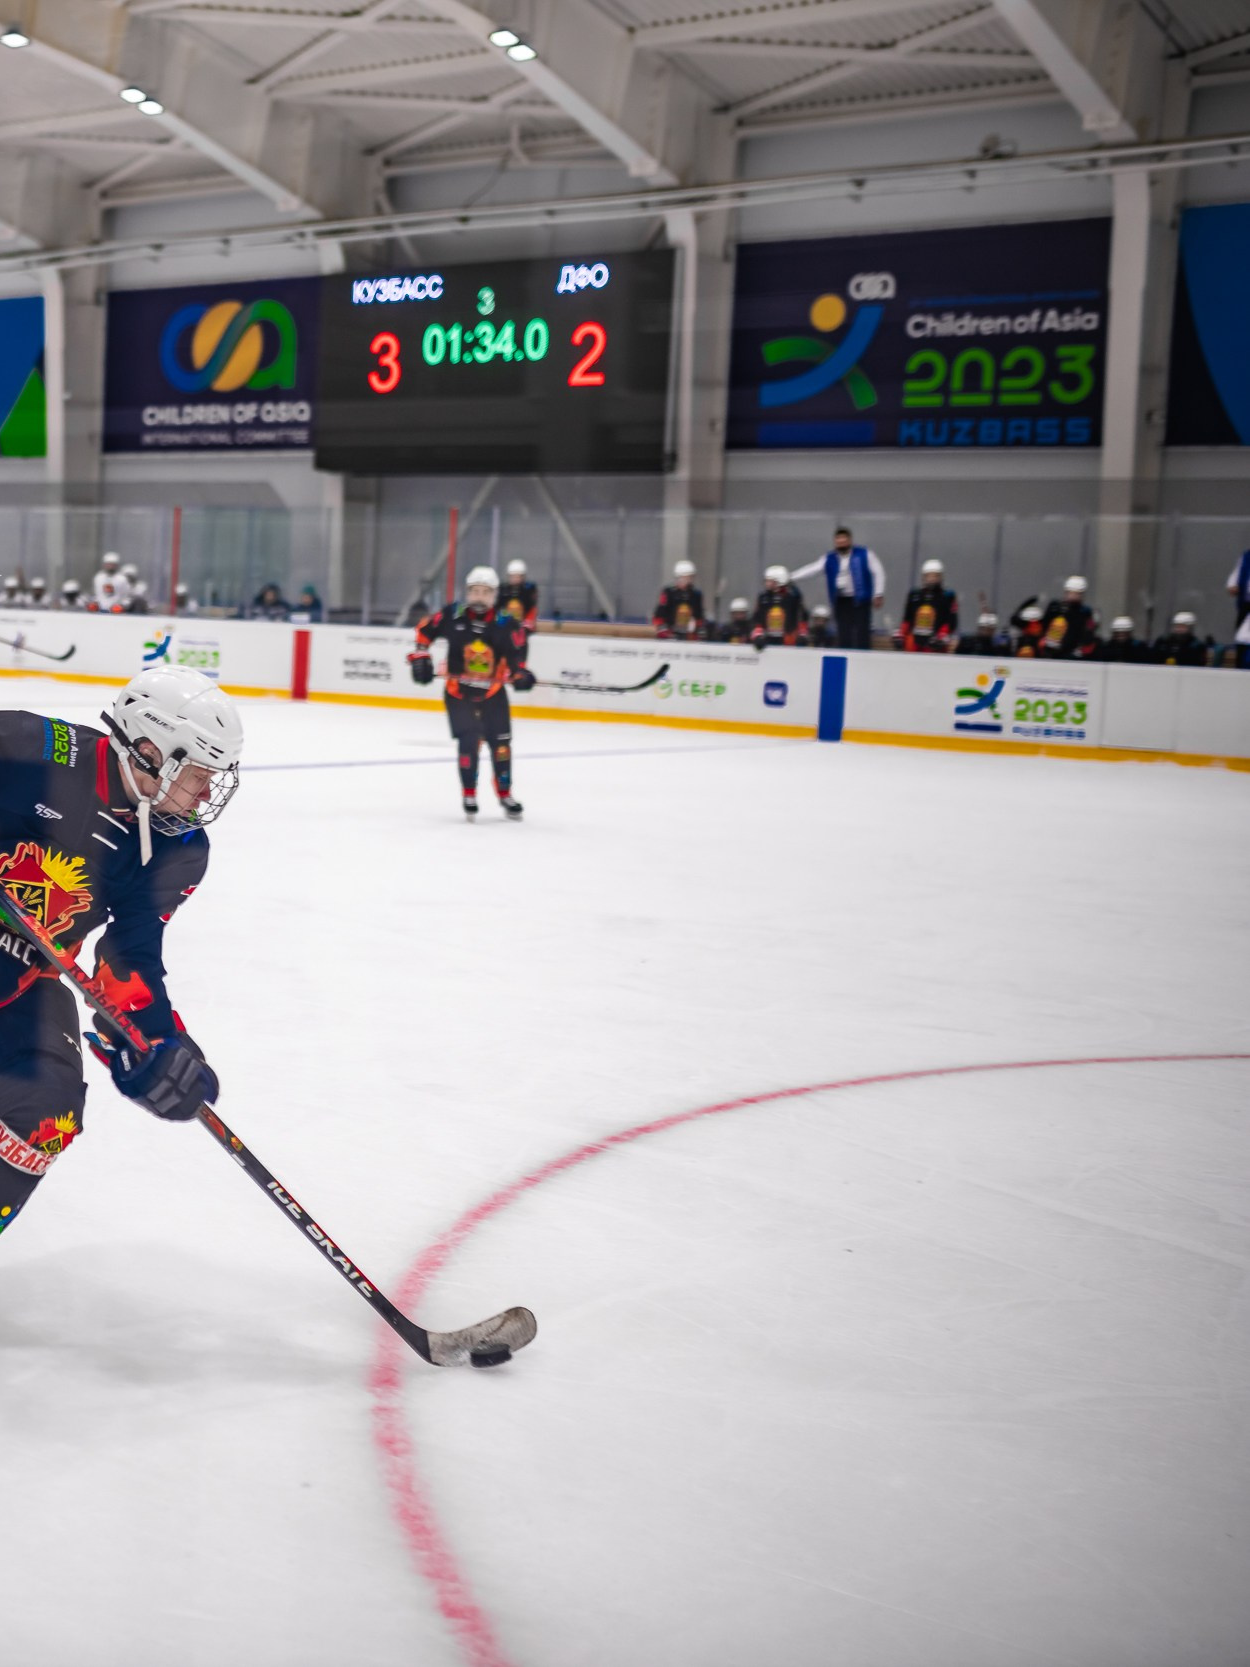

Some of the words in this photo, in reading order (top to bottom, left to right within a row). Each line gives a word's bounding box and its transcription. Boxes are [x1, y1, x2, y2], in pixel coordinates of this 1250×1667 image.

[352, 274, 444, 304] КУЗБАСС
[556, 262, 610, 294] ДФО
[476, 286, 496, 316] 3
[906, 311, 1010, 339] Children
[1013, 309, 1041, 334] of
[1042, 307, 1100, 332] Asia
[422, 317, 550, 366] 01:34.0
[567, 320, 608, 388] 2
[367, 331, 402, 394] 3
[903, 344, 1096, 408] 2023
[142, 404, 231, 427] CHILDREN
[233, 402, 259, 424] OF
[898, 416, 1093, 445] KUZBASS
[142, 431, 232, 446] INTERNATIONAL
[235, 428, 309, 445] COMMITTEE
[1013, 697, 1088, 725] 2023
[52, 723, 69, 765] 2023
[128, 746, 152, 769] BAUER
[266, 1180, 303, 1220] ICE
[305, 1222, 374, 1298] SKATE
